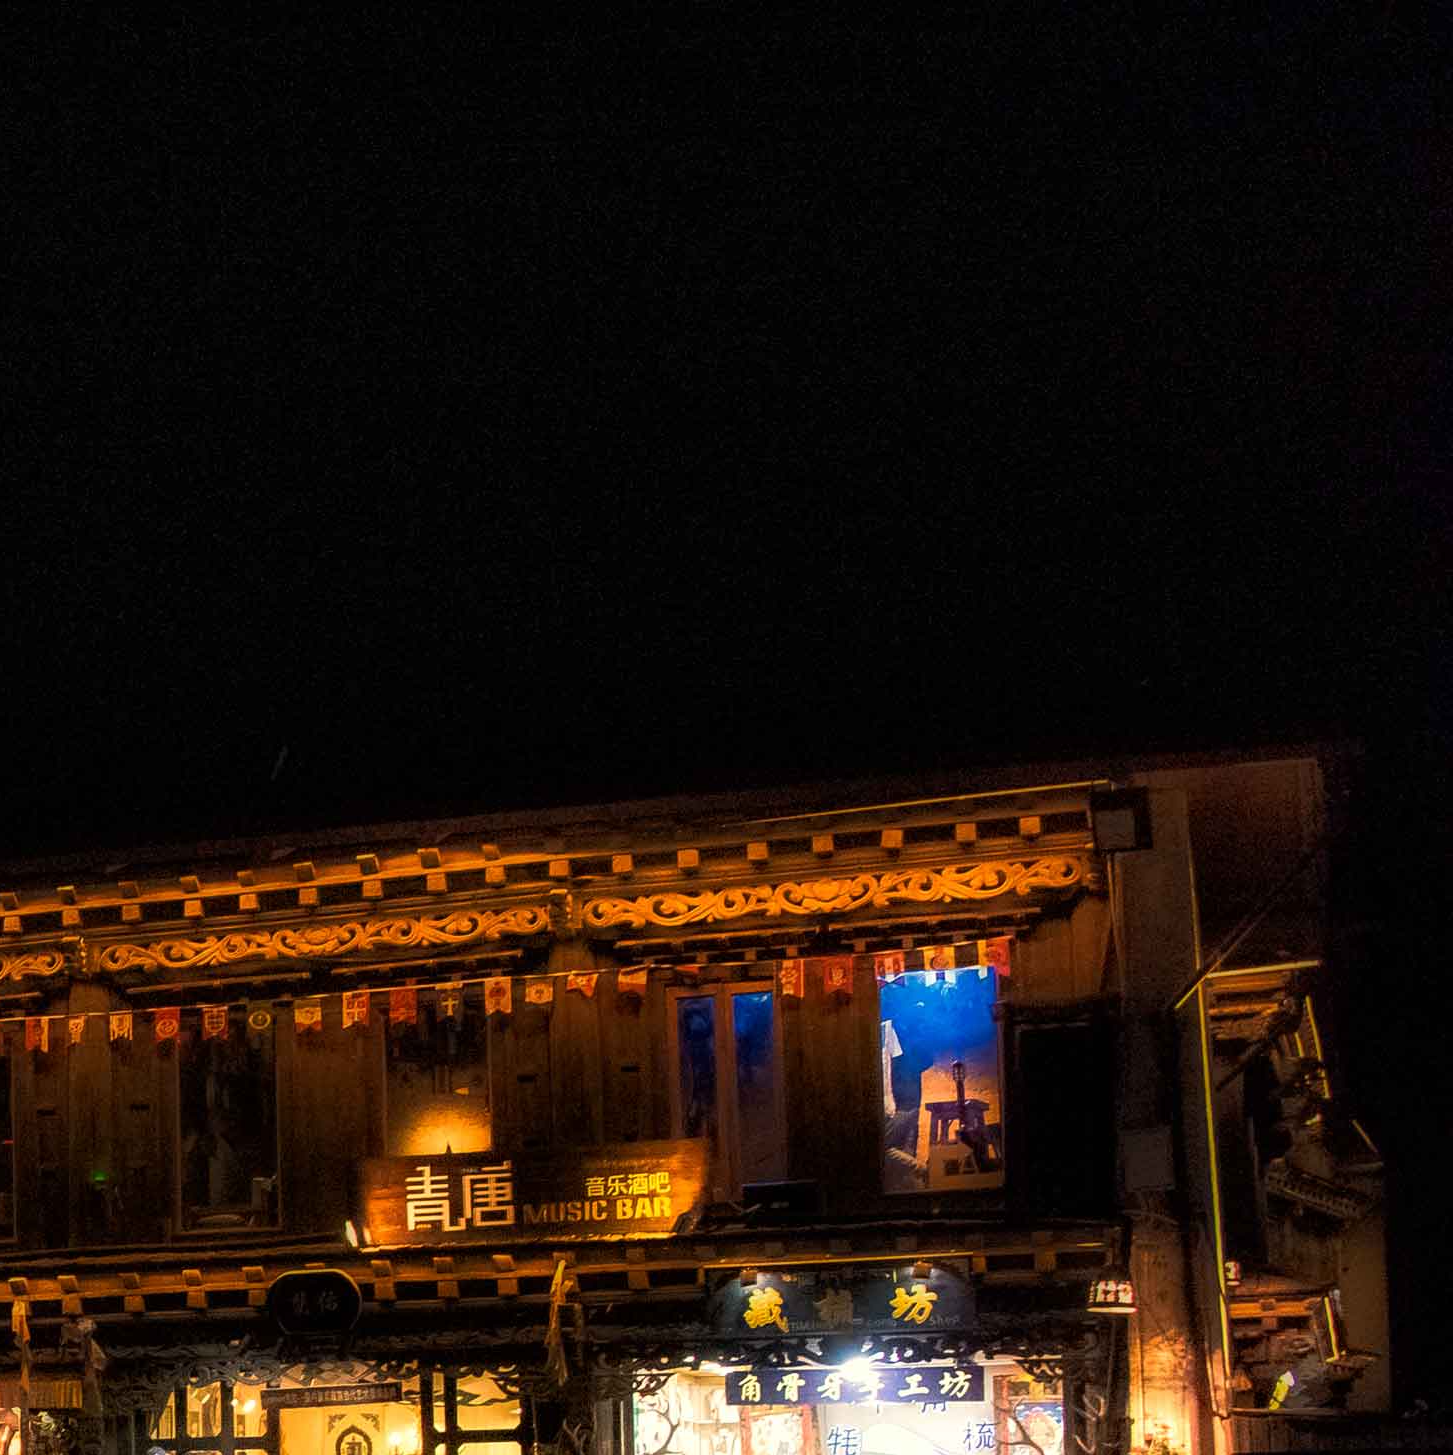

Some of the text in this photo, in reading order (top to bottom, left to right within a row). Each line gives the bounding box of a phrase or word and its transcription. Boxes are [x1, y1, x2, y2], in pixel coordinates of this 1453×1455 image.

[584, 1171, 672, 1198] 音乐酒吧
[523, 1196, 672, 1225] MUSIC BAR
